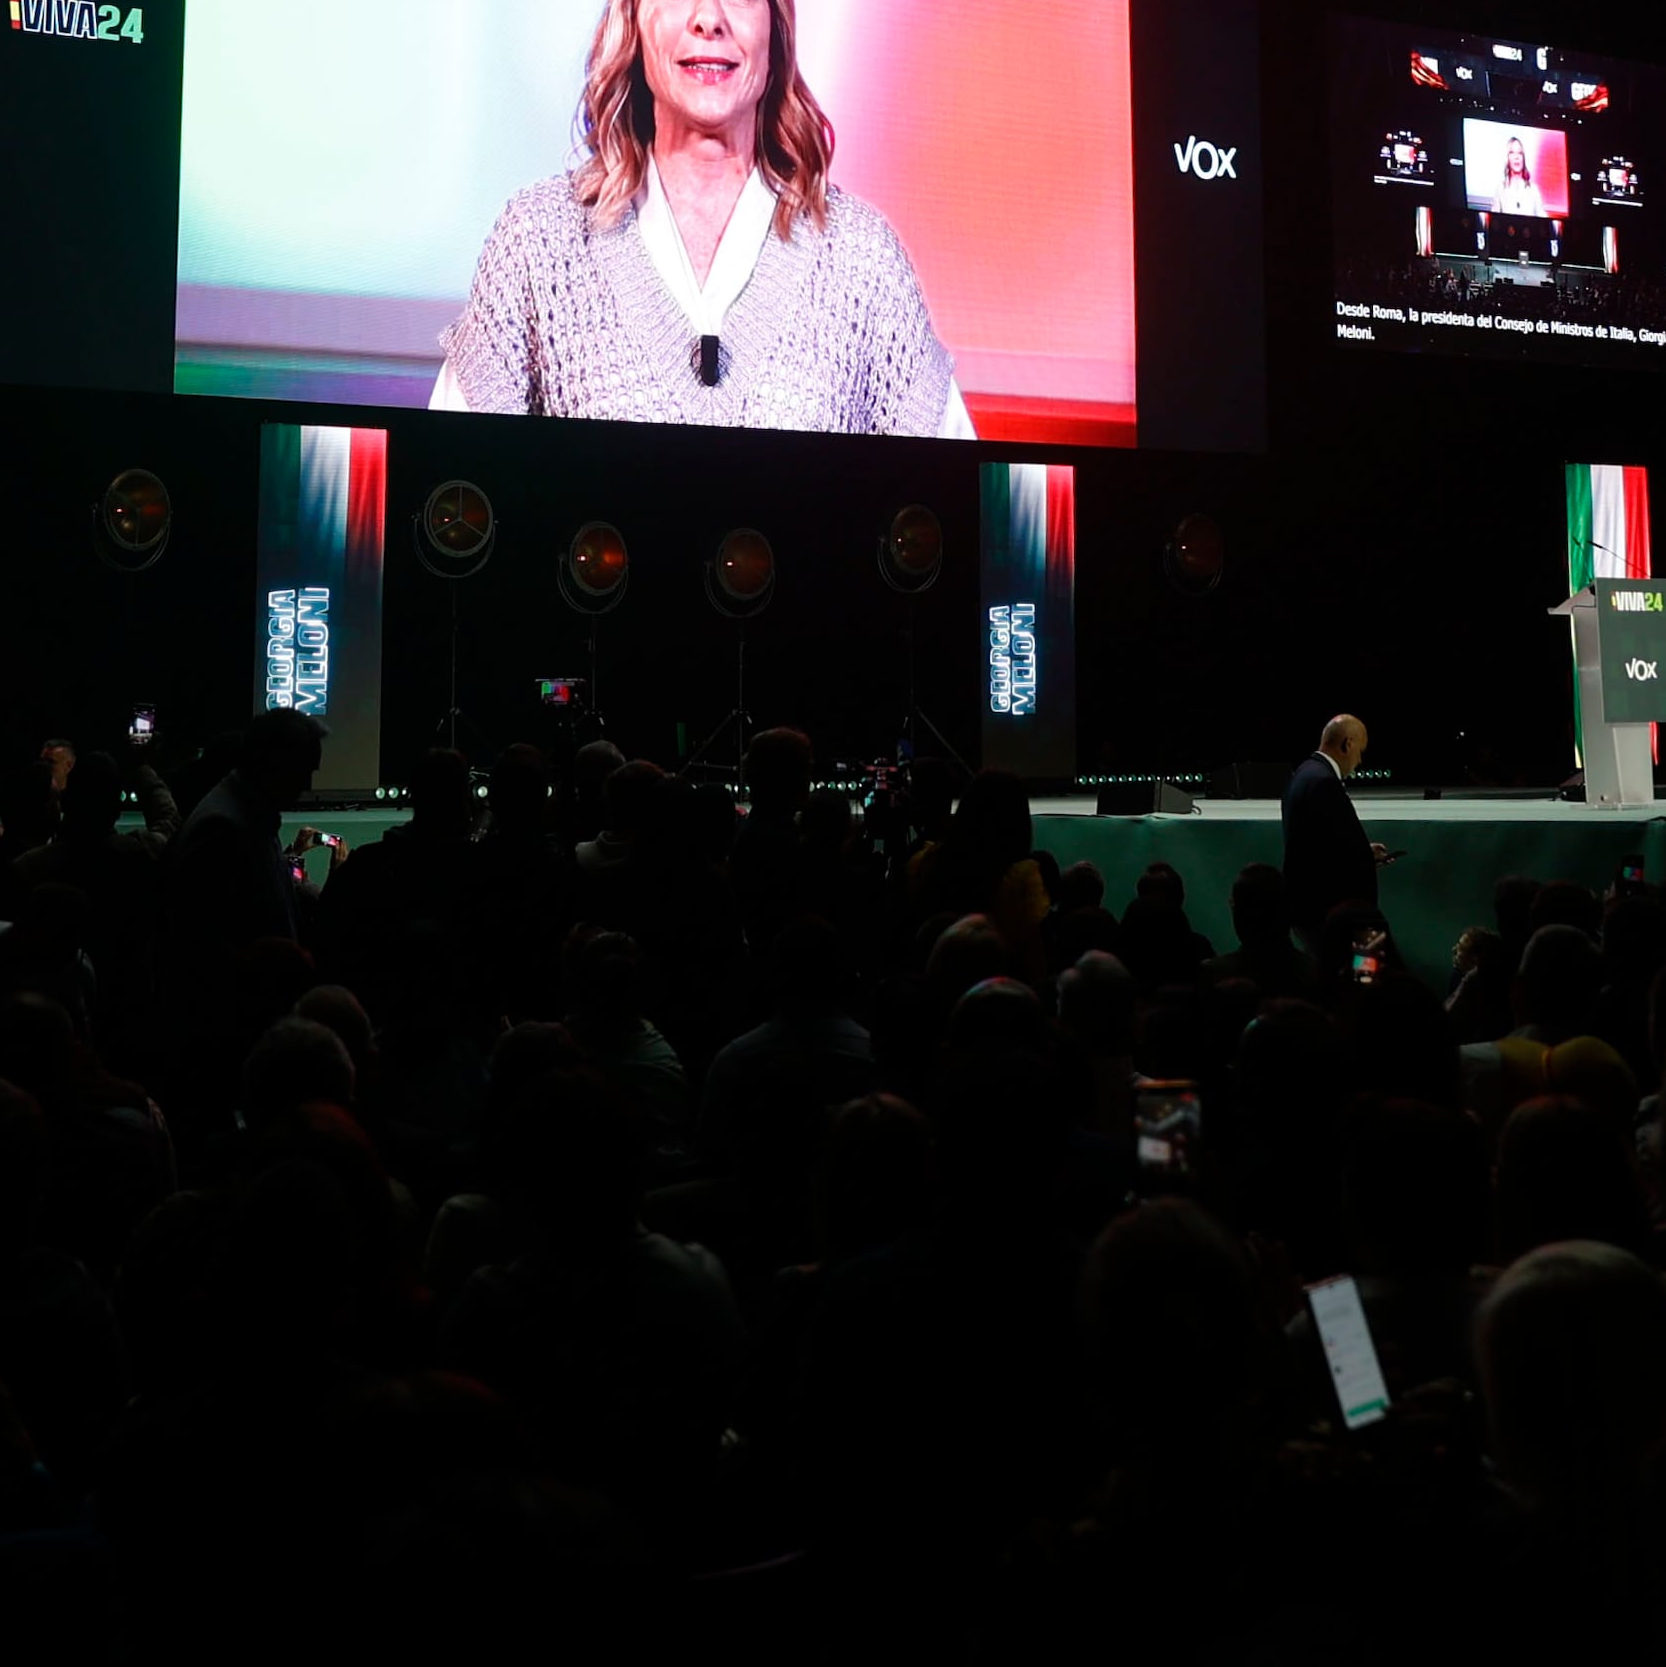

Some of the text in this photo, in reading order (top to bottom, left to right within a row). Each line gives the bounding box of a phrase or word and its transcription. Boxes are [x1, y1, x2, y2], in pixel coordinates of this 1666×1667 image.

[1173, 134, 1238, 181] VOX
[1336, 300, 1371, 317] Desde
[1372, 304, 1407, 324] Roma,
[1408, 307, 1419, 323] la
[1421, 310, 1475, 327] presidenta
[1476, 314, 1493, 329] del
[1494, 315, 1534, 334] Consejo
[1535, 319, 1550, 334] de
[1550, 320, 1594, 338] Ministros
[1595, 324, 1609, 339] de
[1609, 325, 1638, 344] Italia,
[1336, 323, 1376, 341] Meloni.
[294, 586, 331, 717] MELONI
[988, 604, 1012, 715] GEORGIA
[1011, 602, 1037, 716] MELONI
[1624, 656, 1659, 682] VOX
